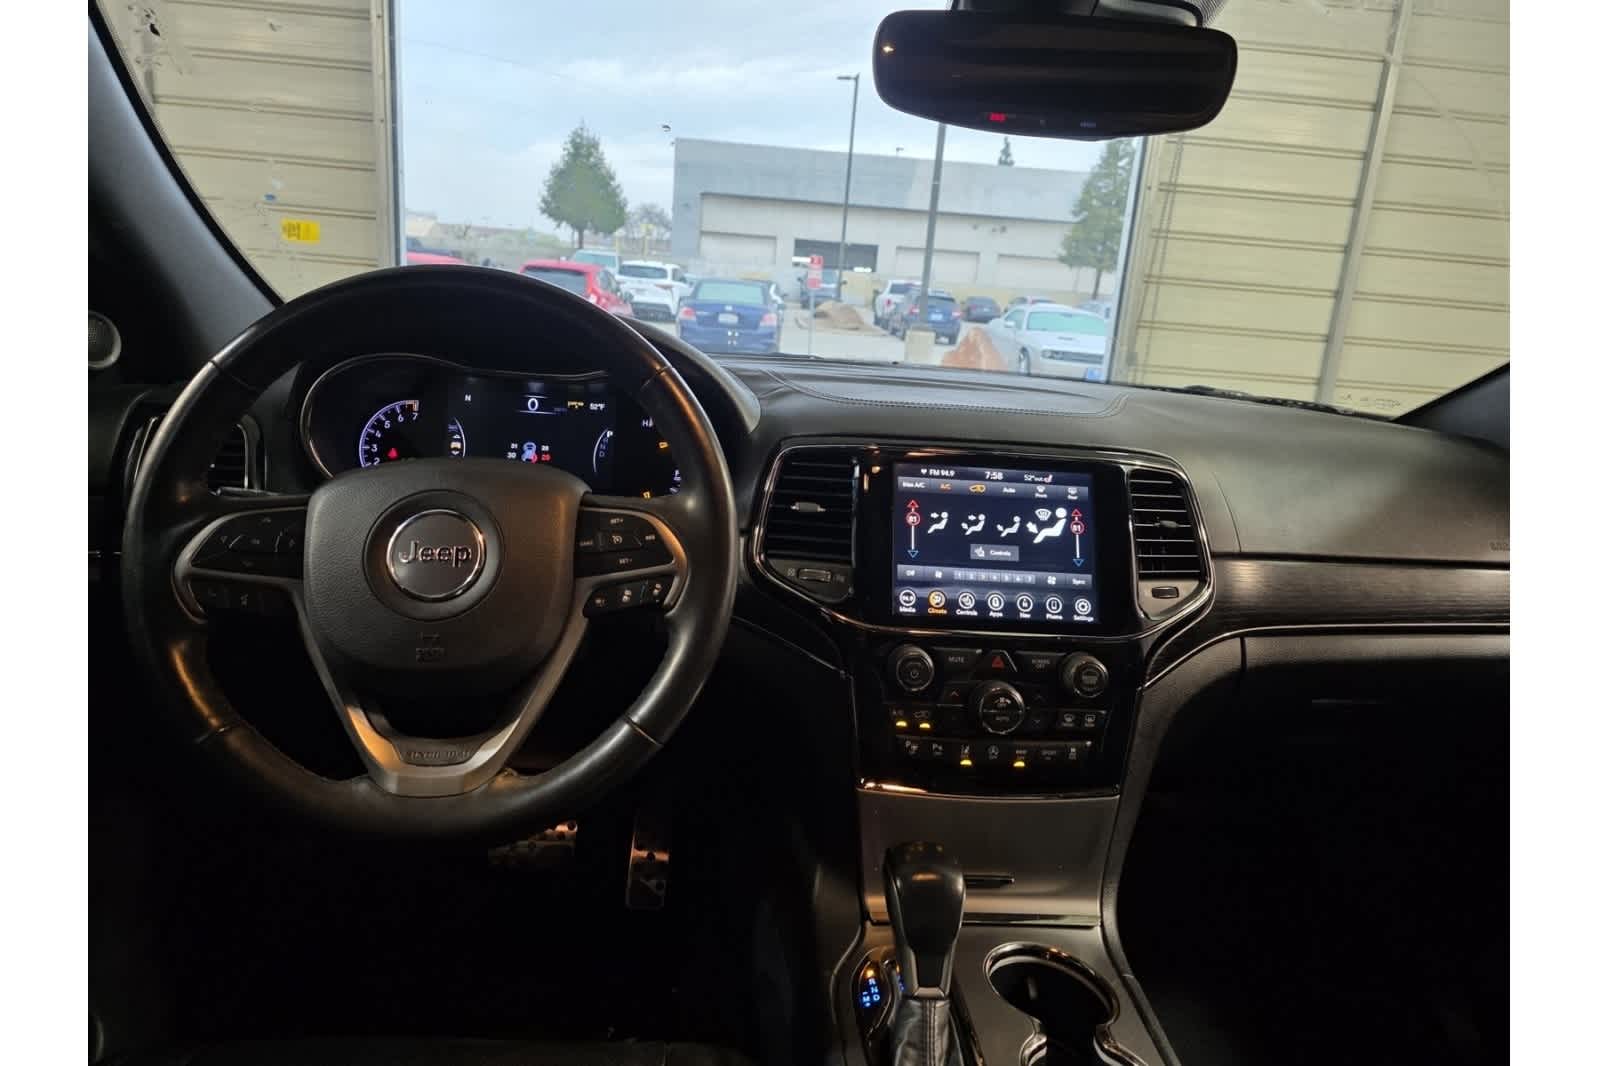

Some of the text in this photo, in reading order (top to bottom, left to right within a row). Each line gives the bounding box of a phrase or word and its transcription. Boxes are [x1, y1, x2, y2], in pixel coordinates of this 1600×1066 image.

[464, 394, 473, 402] N
[398, 414, 405, 423] 6
[412, 412, 419, 421] 7
[383, 420, 392, 430] 5
[375, 430, 382, 438] 4
[370, 443, 379, 453] 3
[507, 451, 517, 459] 30
[929, 468, 956, 478] FM 94.9
[984, 470, 1004, 481] 7:58
[398, 540, 472, 568] Jeep
